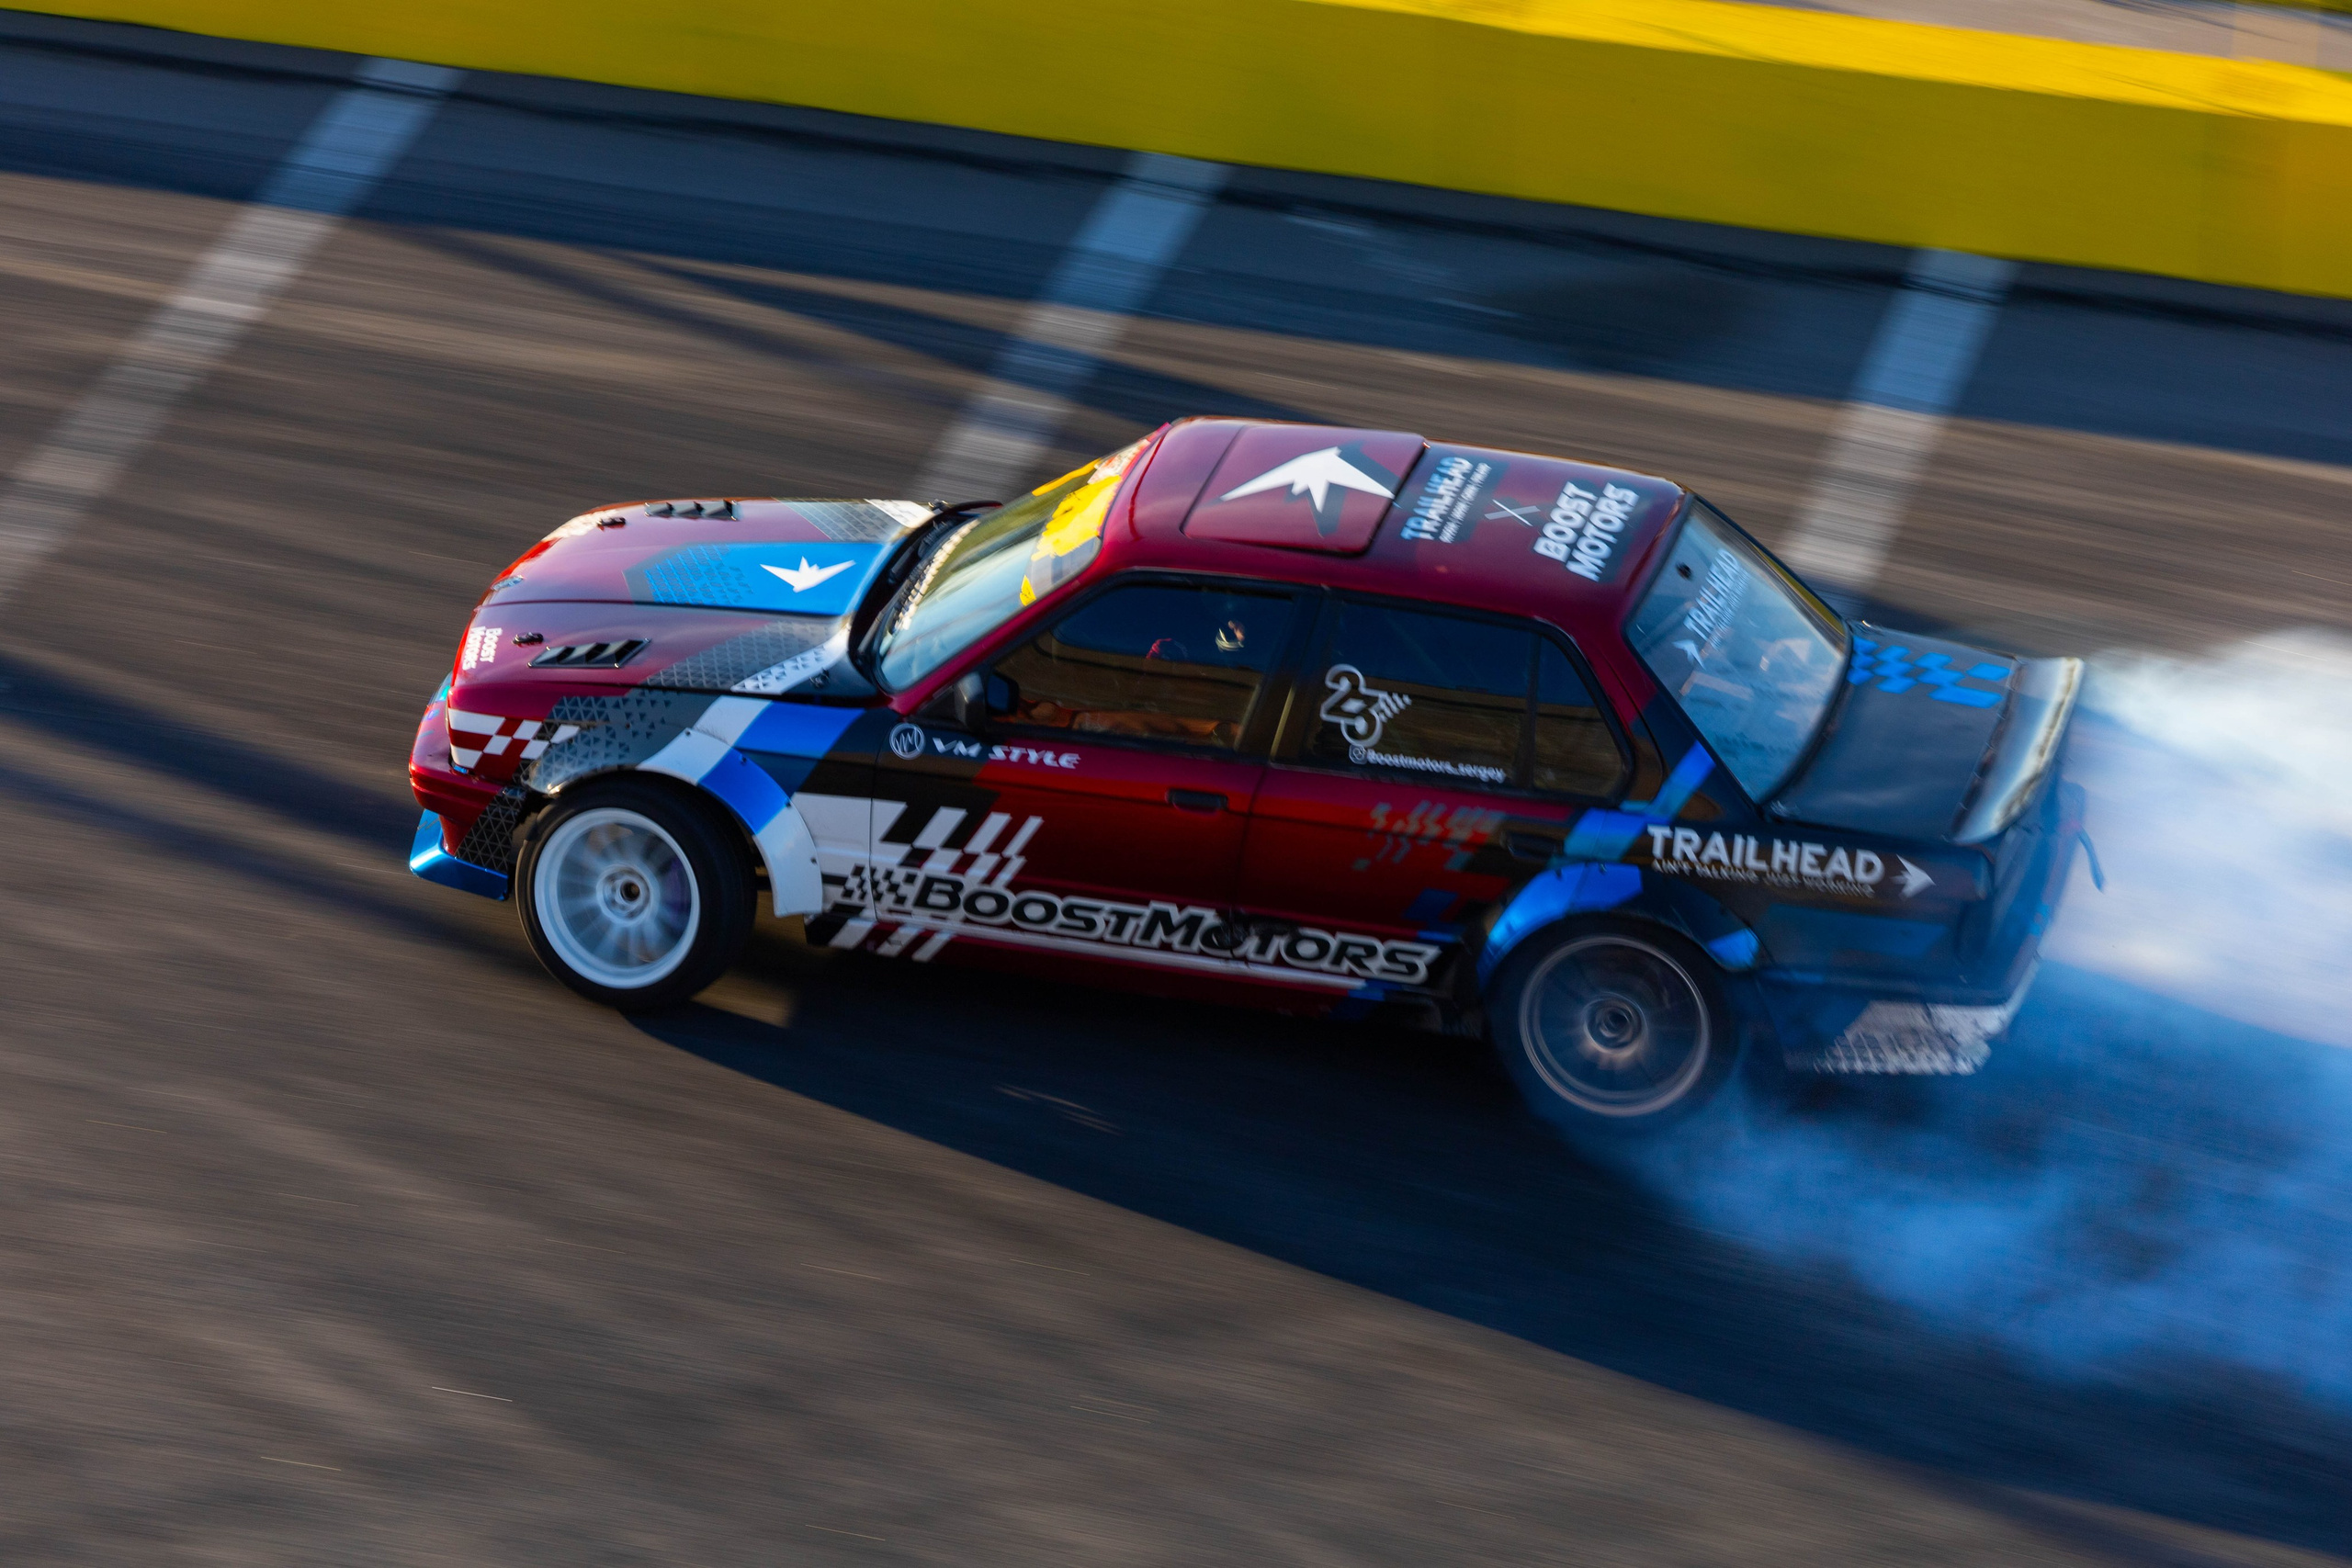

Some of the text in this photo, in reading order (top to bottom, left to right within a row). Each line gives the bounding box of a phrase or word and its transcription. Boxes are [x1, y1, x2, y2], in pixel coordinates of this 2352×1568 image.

[1400, 457, 1474, 542] TRAILHEAD
[1532, 480, 1599, 563] BOOST
[1566, 482, 1640, 583] MOTORS
[1682, 548, 1741, 643] TRAILHEAD
[479, 627, 503, 663] BOOST
[988, 744, 1082, 770] STYLE
[1647, 824, 1885, 885] TRAILHEAD
[913, 875, 1441, 985] BOOSTMOTORS
